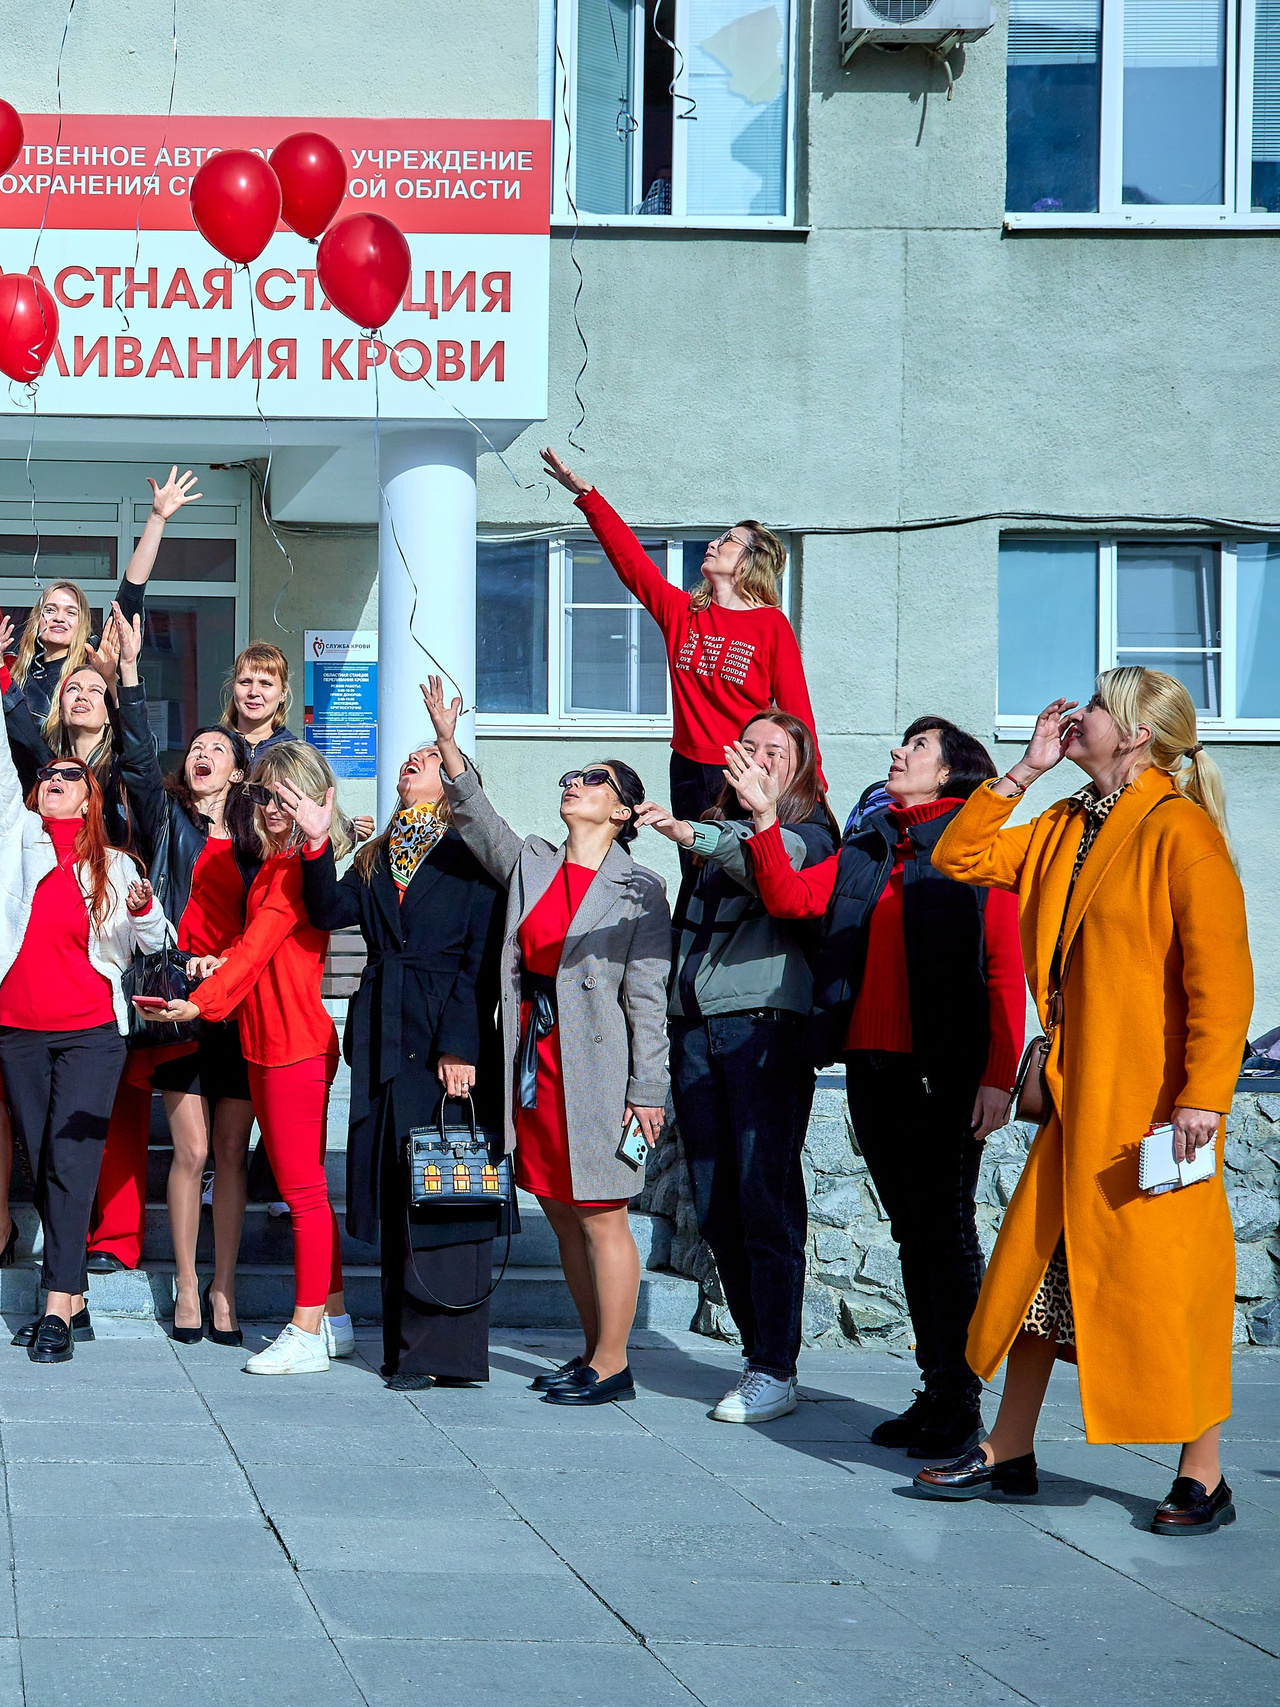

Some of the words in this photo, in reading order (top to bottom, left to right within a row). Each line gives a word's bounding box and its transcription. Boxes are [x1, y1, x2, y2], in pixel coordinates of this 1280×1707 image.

[351, 149, 533, 174] УЧРЕЖДЕНИЕ
[395, 178, 521, 200] ОБЛАСТИ
[255, 268, 512, 319] СТЦИЯ
[321, 338, 506, 382] КРОВИ
[728, 646, 754, 658] LOUDER
[731, 640, 756, 652] LOUDER
[724, 658, 749, 671] LOUDER
[726, 652, 751, 664] LOUDER
[721, 665, 747, 678] LOUDER
[720, 673, 744, 685] LOUDER
